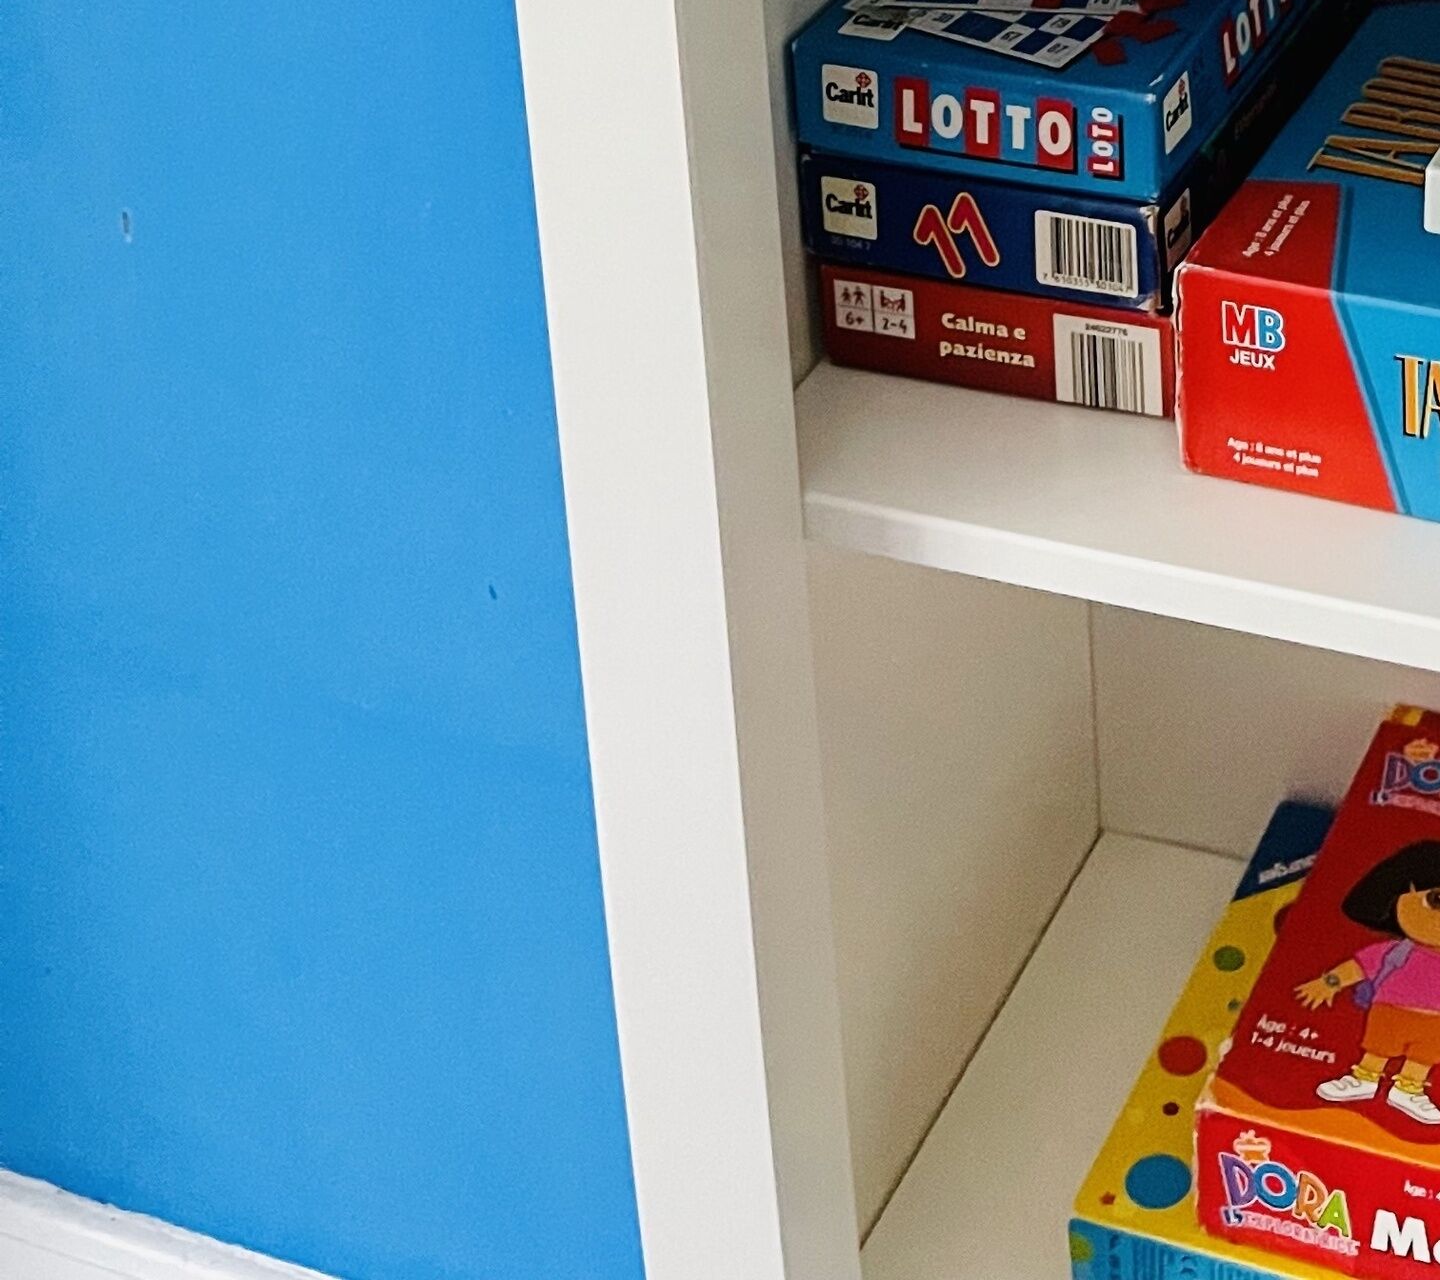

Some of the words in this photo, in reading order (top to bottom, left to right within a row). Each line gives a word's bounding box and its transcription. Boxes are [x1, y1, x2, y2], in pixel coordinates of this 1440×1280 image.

[825, 81, 875, 109] Carlit
[902, 88, 1073, 156] LOTTO
[1091, 106, 1115, 173] LOTO
[825, 193, 874, 220] Carlit
[844, 310, 864, 326] 6+
[882, 316, 908, 335] 2-4
[940, 311, 1009, 340] Calma
[1012, 326, 1027, 340] e
[1221, 300, 1286, 353] MB
[939, 340, 1036, 370] pazienza
[1229, 348, 1276, 371] JEUX
[1241, 452, 1282, 471] joueurs
[1283, 462, 1296, 473] et
[1295, 464, 1320, 478] plus
[1285, 449, 1297, 460] et
[1298, 451, 1322, 465] plus
[1298, 1026, 1320, 1040] 4+
[1250, 1030, 1275, 1048] 1-4
[1274, 1037, 1337, 1065] joueurs
[1217, 1151, 1352, 1239] DORA
